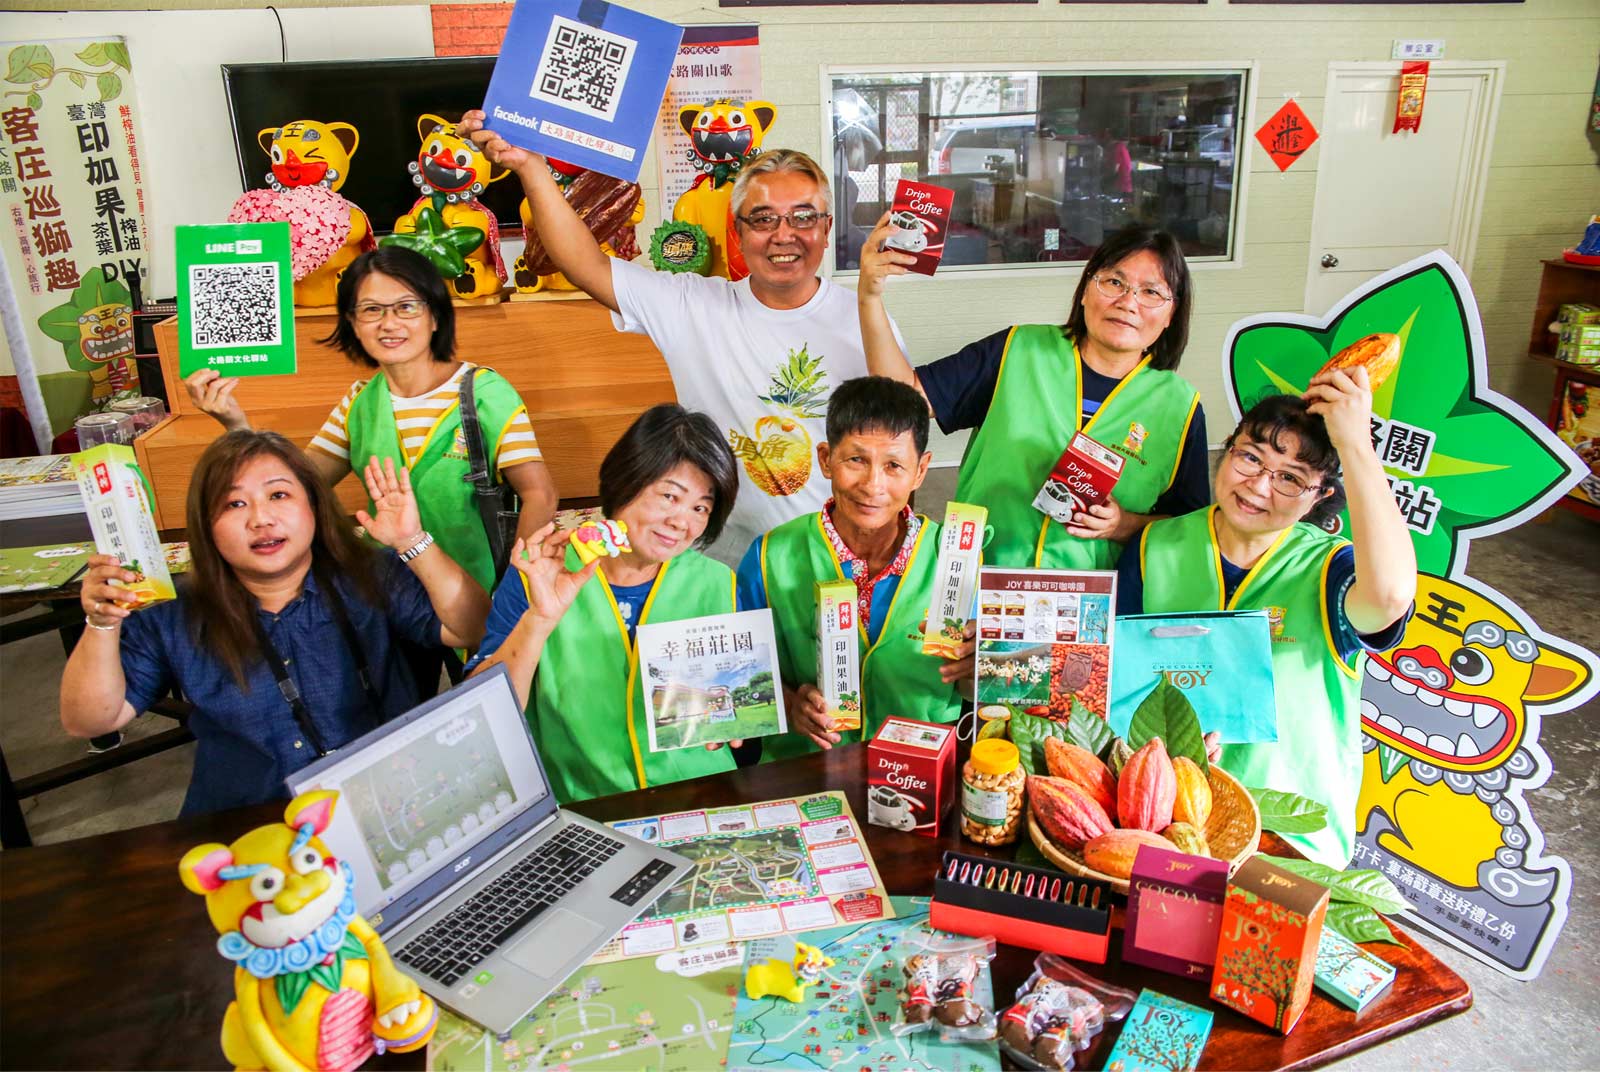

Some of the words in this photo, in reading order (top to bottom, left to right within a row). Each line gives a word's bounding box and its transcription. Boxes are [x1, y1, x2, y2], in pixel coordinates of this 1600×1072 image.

[670, 64, 733, 78] 路關山歌
[66, 101, 106, 122] 臺灣
[493, 105, 539, 131] facebook
[76, 121, 125, 252] 印加果
[905, 187, 926, 200] Drip
[1, 106, 81, 293] 客庄巡獅趣
[910, 200, 943, 215] Coffee
[91, 221, 115, 256] 茶葉
[119, 217, 141, 252] 榨油
[205, 243, 236, 254] LINE
[101, 257, 141, 284] DIY
[1066, 461, 1088, 479] Drip
[1067, 475, 1099, 499] Coffee
[1387, 479, 1437, 531] 站
[943, 560, 963, 617] 印加果油
[1005, 580, 1023, 590] JOY
[660, 631, 753, 661] 幸福莊園
[835, 640, 849, 693] 印加果油
[878, 757, 903, 773] Drip
[886, 771, 928, 790] Coffee
[454, 856, 472, 873] acer
[1135, 881, 1199, 905] COCOA
